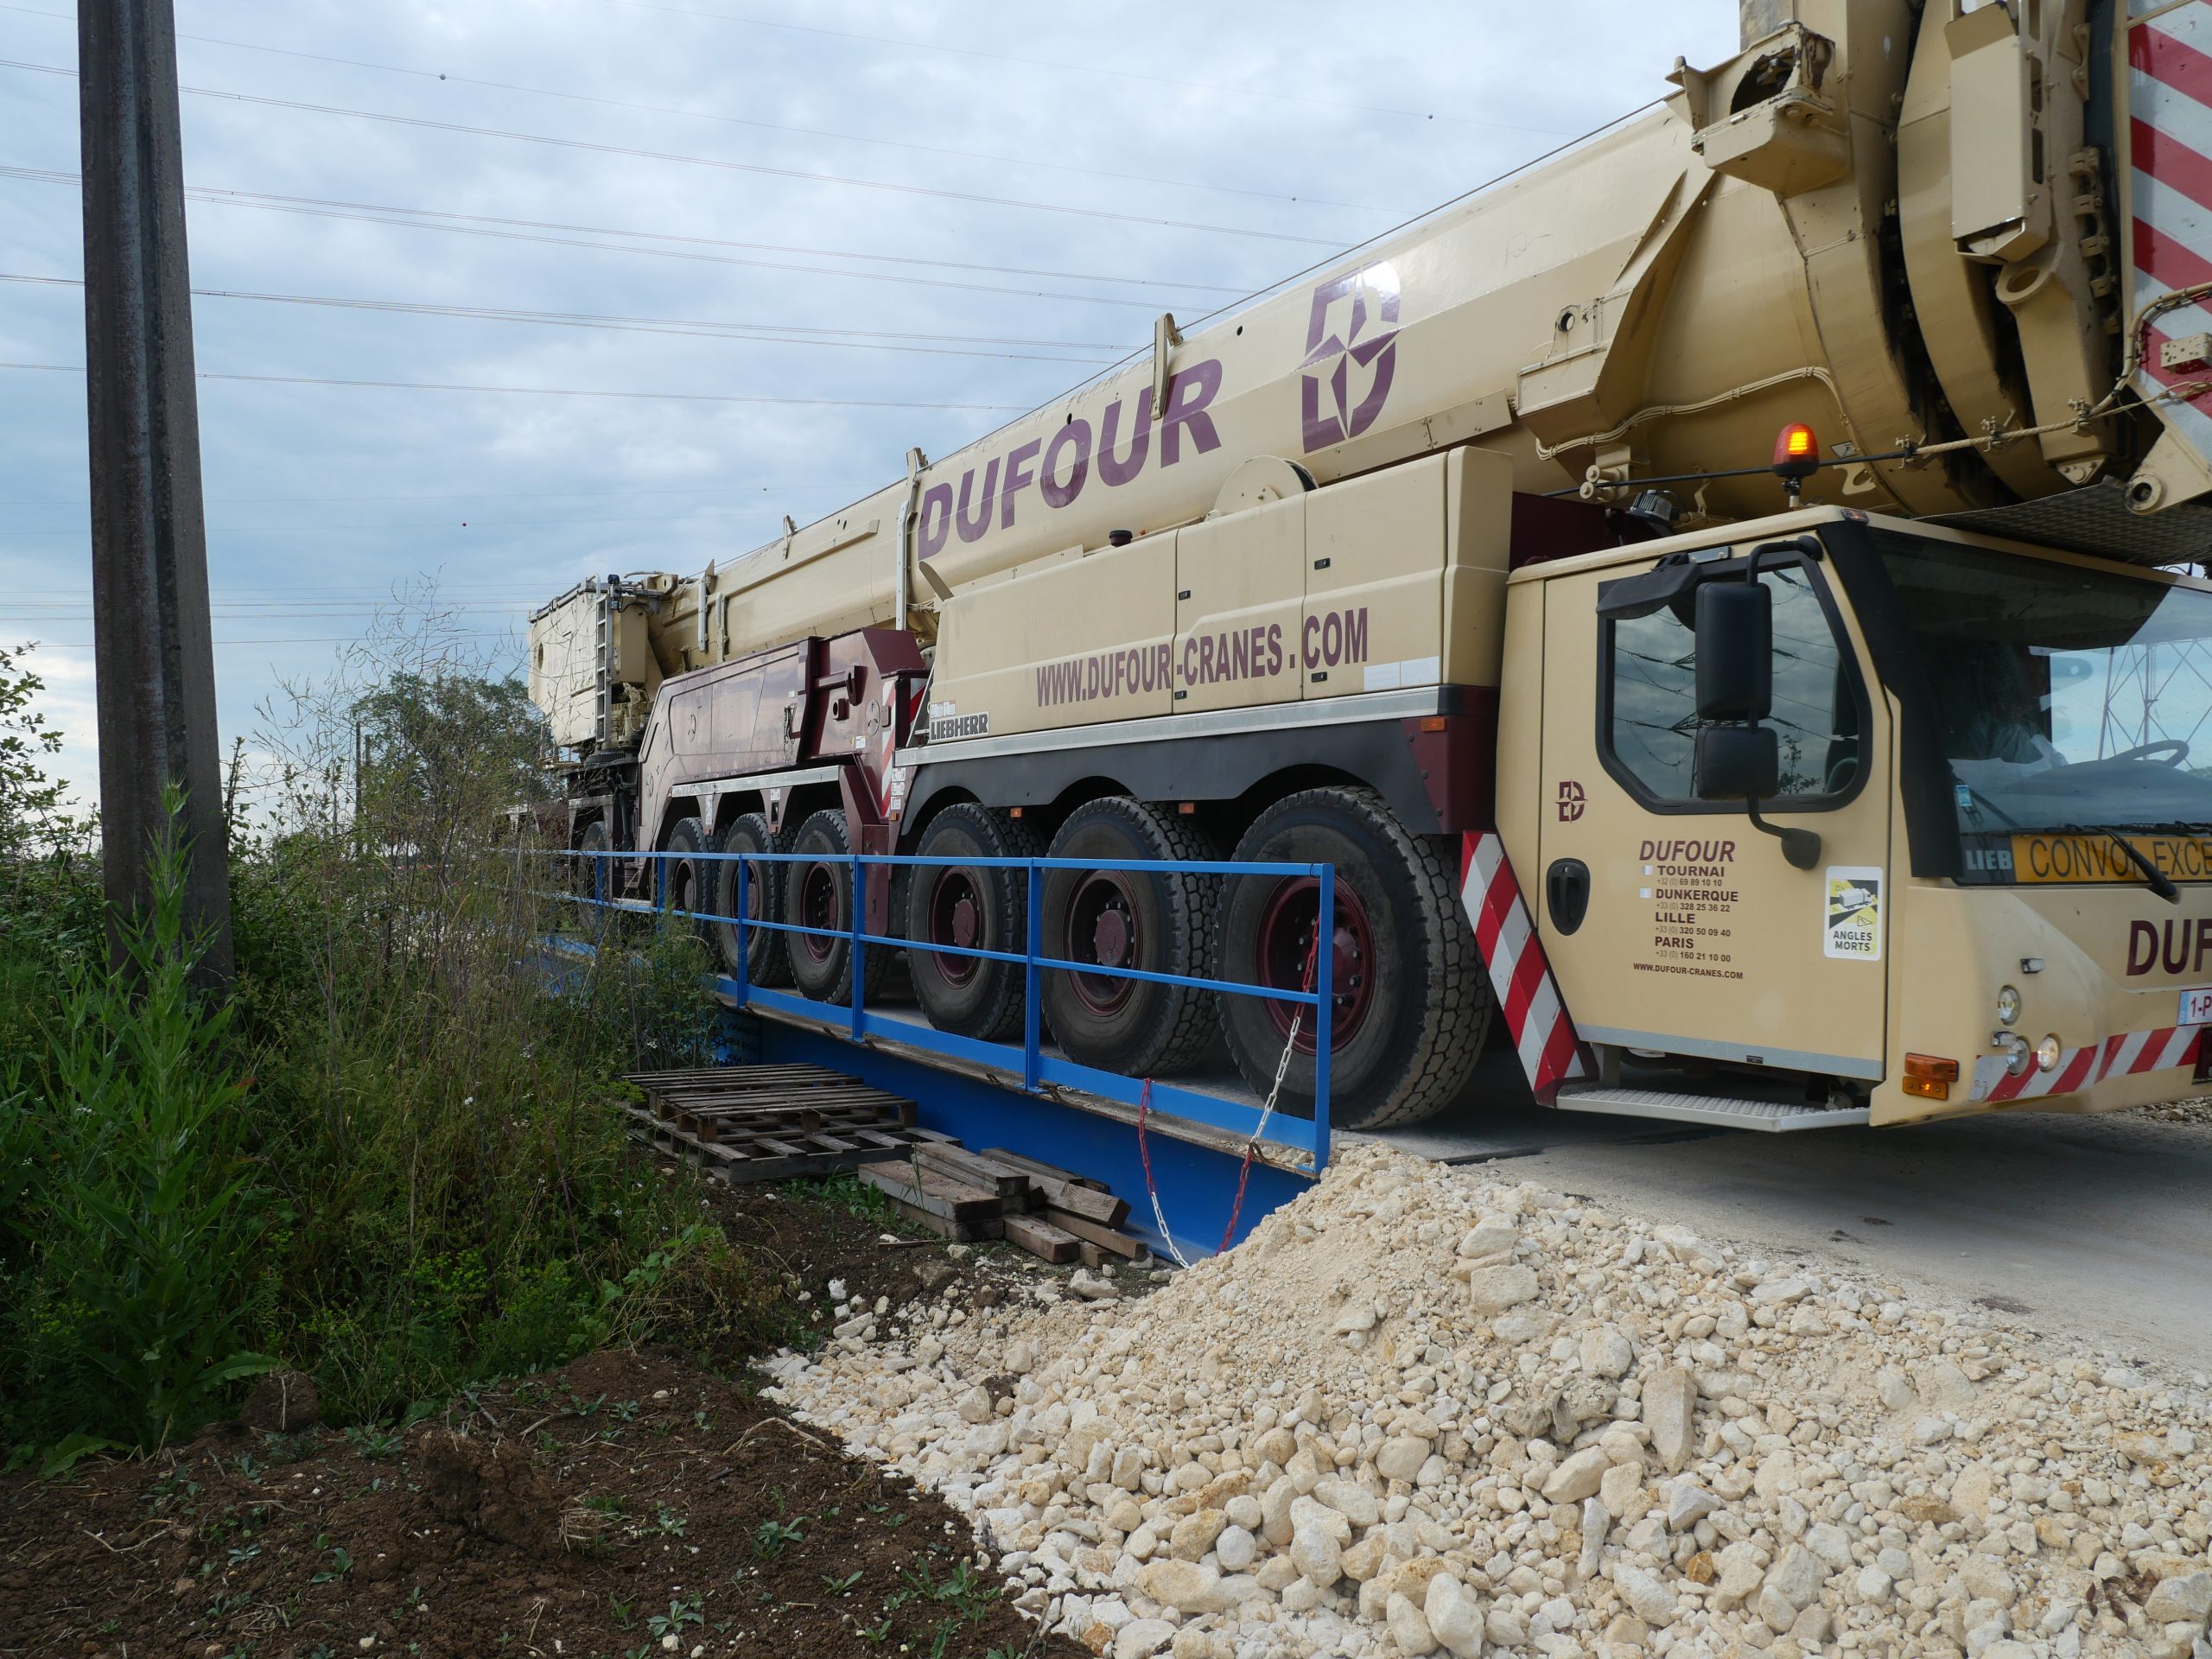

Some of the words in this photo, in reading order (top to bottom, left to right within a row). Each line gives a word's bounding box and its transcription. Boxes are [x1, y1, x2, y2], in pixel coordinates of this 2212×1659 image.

[918, 359, 1223, 561] DUFOUR
[931, 713, 988, 741] LIEBHERR
[1639, 840, 1736, 862] DUFOUR
[1657, 865, 1725, 877] TOURNAI
[1657, 877, 1669, 886] +32
[1669, 878, 1679, 887] (0)
[1656, 888, 1738, 902] DUNKERQUE
[1669, 902, 1679, 911] (0)
[1656, 912, 1695, 924] LILLE
[1669, 926, 1678, 935] (0)
[1833, 931, 1872, 941] ANGLES
[1655, 936, 1694, 949] PARIS
[1834, 940, 1871, 951] MORTS
[2126, 918, 2212, 976] DUF
[1669, 950, 1678, 959] (0)
[1680, 951, 1694, 960] 160
[1633, 963, 1744, 979] WWW.DUFOUR-CRANES.COM
